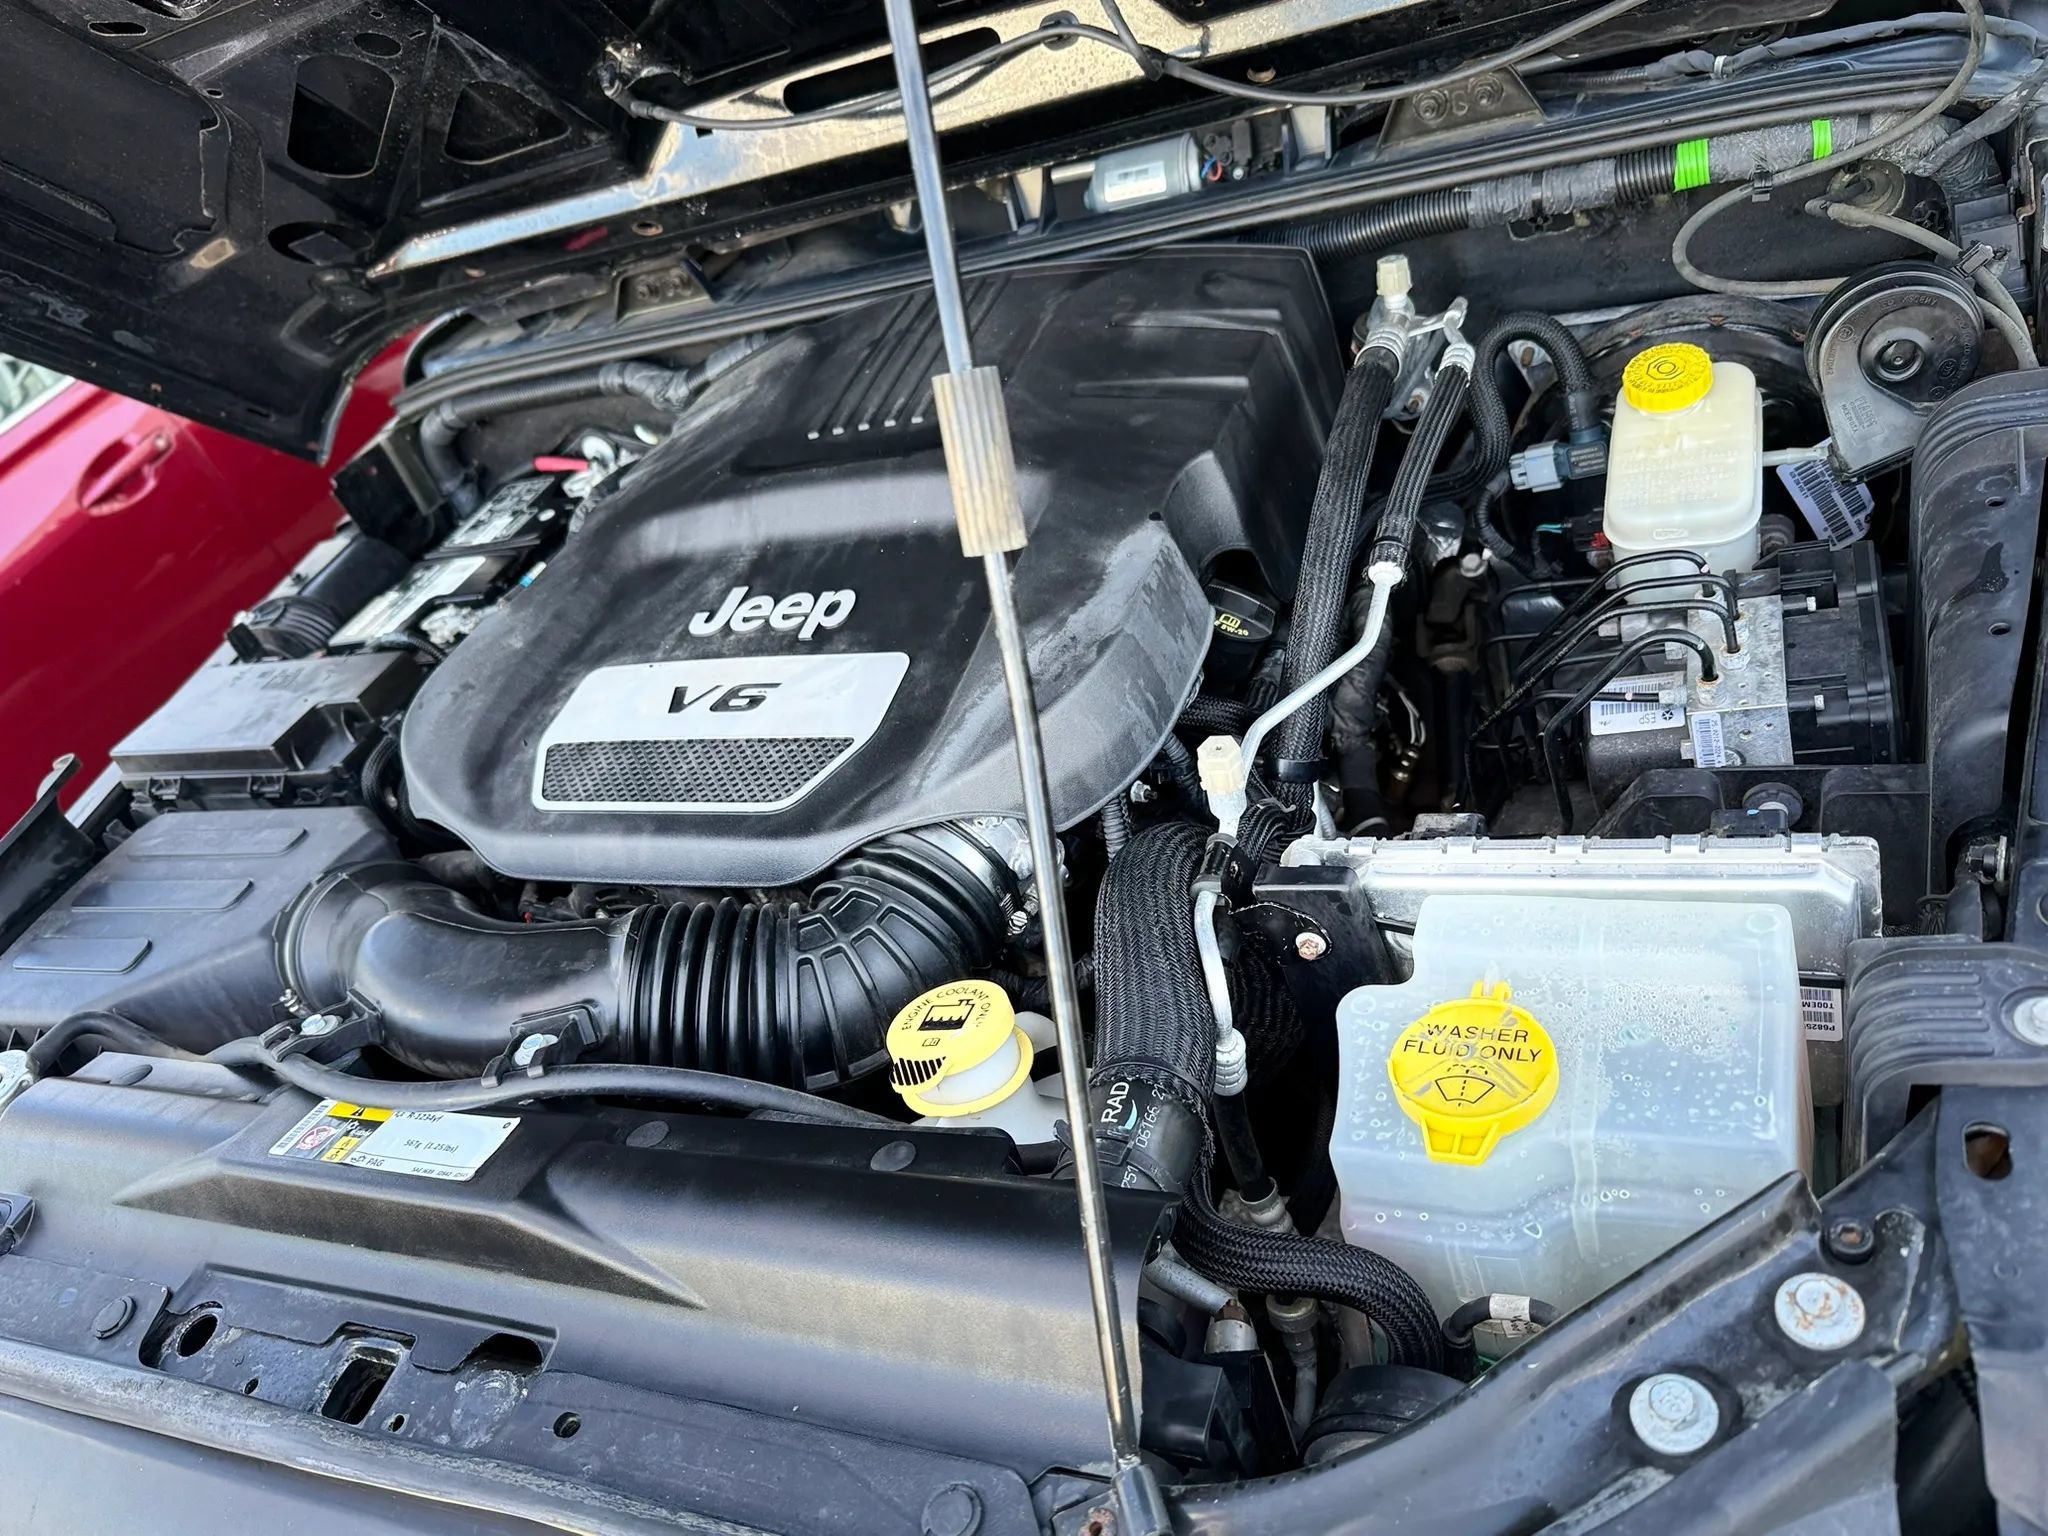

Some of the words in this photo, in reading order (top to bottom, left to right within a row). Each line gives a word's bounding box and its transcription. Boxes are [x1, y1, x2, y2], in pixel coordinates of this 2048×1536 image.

[688, 586, 856, 641] Jeep
[668, 683, 783, 714] V6
[1638, 712, 1657, 725] ESP
[902, 999, 933, 1031] ENGINE
[936, 986, 990, 1003] COOLANT
[1427, 1023, 1529, 1043] WASHER
[1403, 1039, 1473, 1058] FLUID
[1479, 1045, 1543, 1063] ONLY
[1101, 1081, 1130, 1124] RAD
[407, 1111, 444, 1122] R-1234yf
[366, 1158, 384, 1167] PAG
